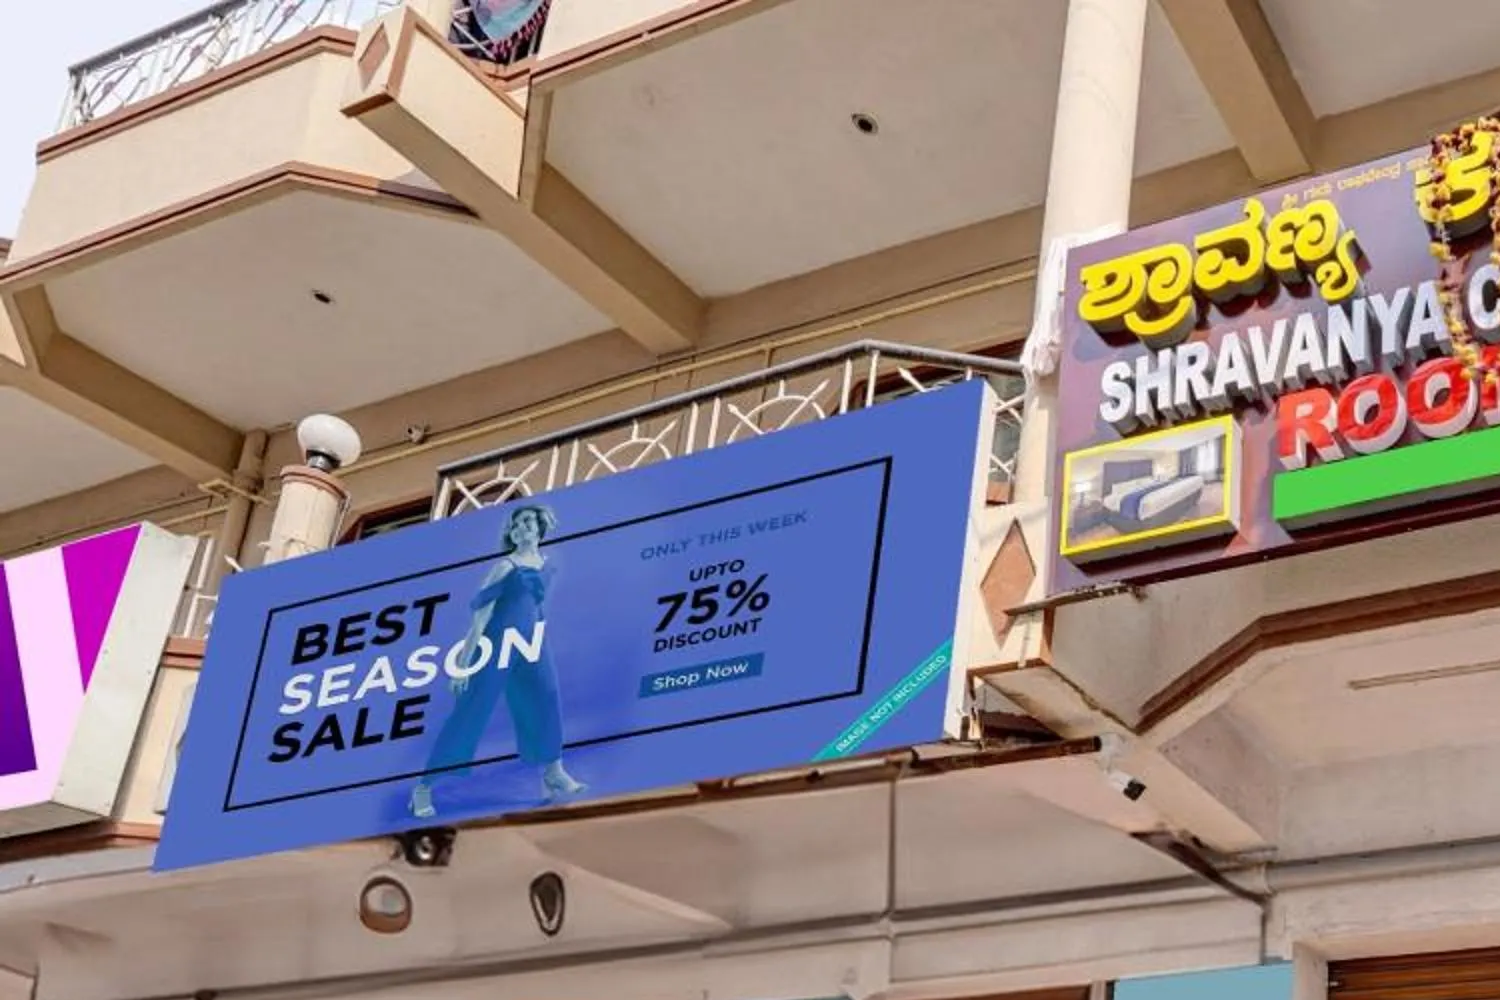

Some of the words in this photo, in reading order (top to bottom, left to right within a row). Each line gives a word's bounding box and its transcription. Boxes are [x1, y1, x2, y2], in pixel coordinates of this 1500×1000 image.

[1078, 197, 1357, 336] ಶ್ರಾವಣ್ಯ
[1099, 279, 1450, 423] SHRAVANYA
[640, 536, 690, 561] ONLY
[699, 525, 743, 548] THIS
[748, 510, 809, 536] WEEK
[655, 573, 770, 634] 75%
[688, 559, 746, 582] UPTO
[290, 592, 451, 666] BEST
[653, 617, 763, 654] DISCOUNT
[279, 616, 545, 715] SEASON
[652, 670, 700, 692] Shop
[706, 660, 749, 680] Now
[869, 702, 893, 723] NOT
[892, 655, 946, 702] INCLUDED
[267, 693, 430, 764] SALE
